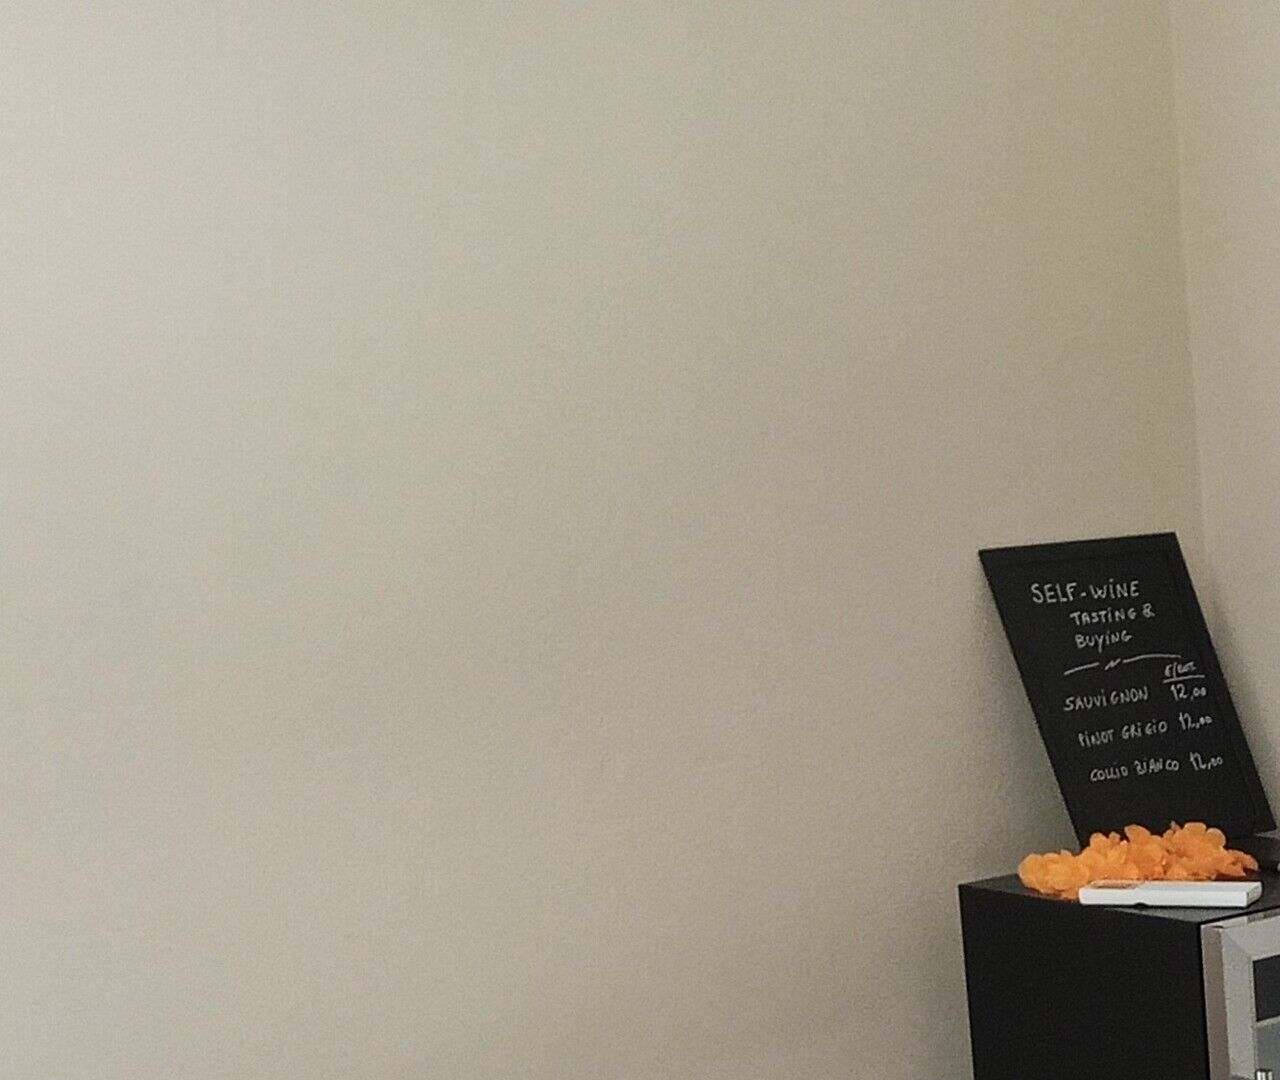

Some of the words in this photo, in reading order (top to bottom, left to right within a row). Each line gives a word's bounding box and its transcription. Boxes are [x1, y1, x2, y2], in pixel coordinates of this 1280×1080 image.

[1069, 607, 1138, 625] TASTING
[1142, 603, 1156, 619] &
[1075, 630, 1134, 653] BUYING
[1063, 686, 1149, 711] SAUVIGNON
[1078, 729, 1115, 748] PINOT
[1121, 719, 1168, 740] GRIGIO
